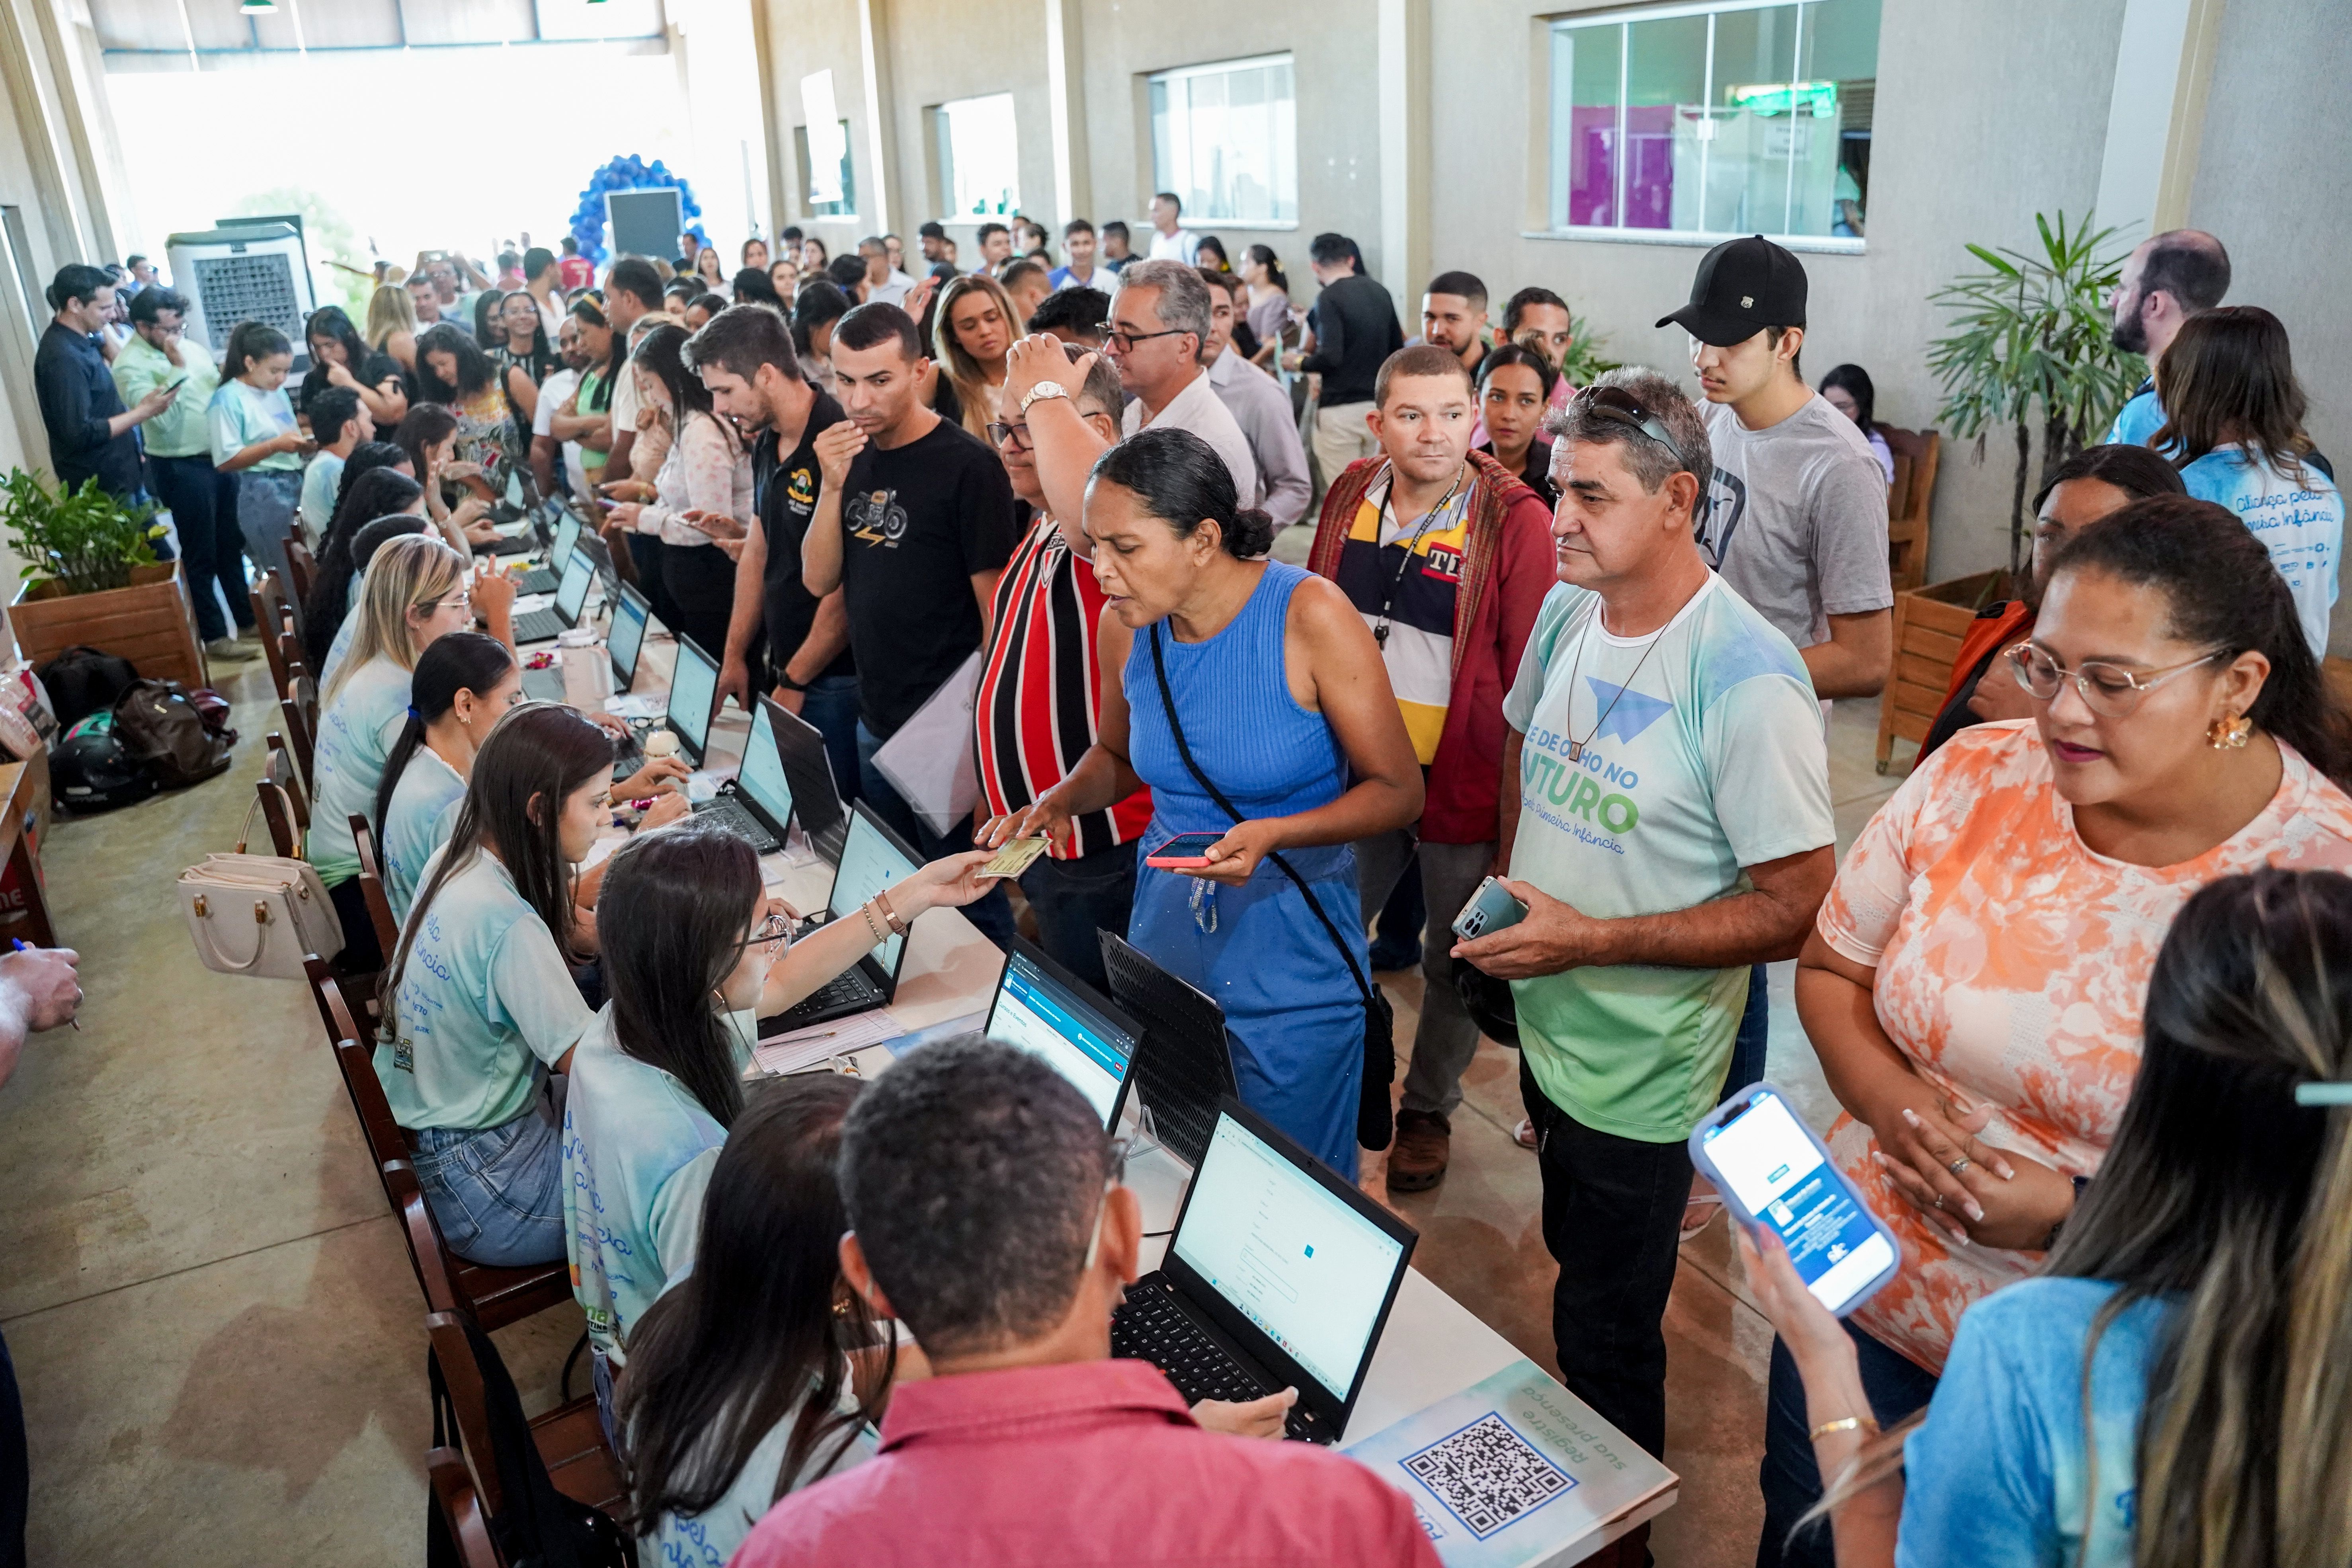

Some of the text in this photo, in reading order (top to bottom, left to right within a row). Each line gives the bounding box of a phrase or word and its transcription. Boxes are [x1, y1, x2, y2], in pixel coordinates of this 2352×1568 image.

[1537, 729, 1560, 752] DE
[1559, 739, 1603, 773] OHO
[1603, 762, 1639, 789] NO
[1520, 746, 1639, 834] UTURO
[1535, 803, 1571, 833] Primeira
[1572, 823, 1625, 855] Infância
[999, 1001, 1010, 1013] Cursos
[1013, 1013, 1027, 1027] Eventos
[1521, 1386, 1628, 1470] sua presença
[1522, 1410, 1589, 1464] Registre
